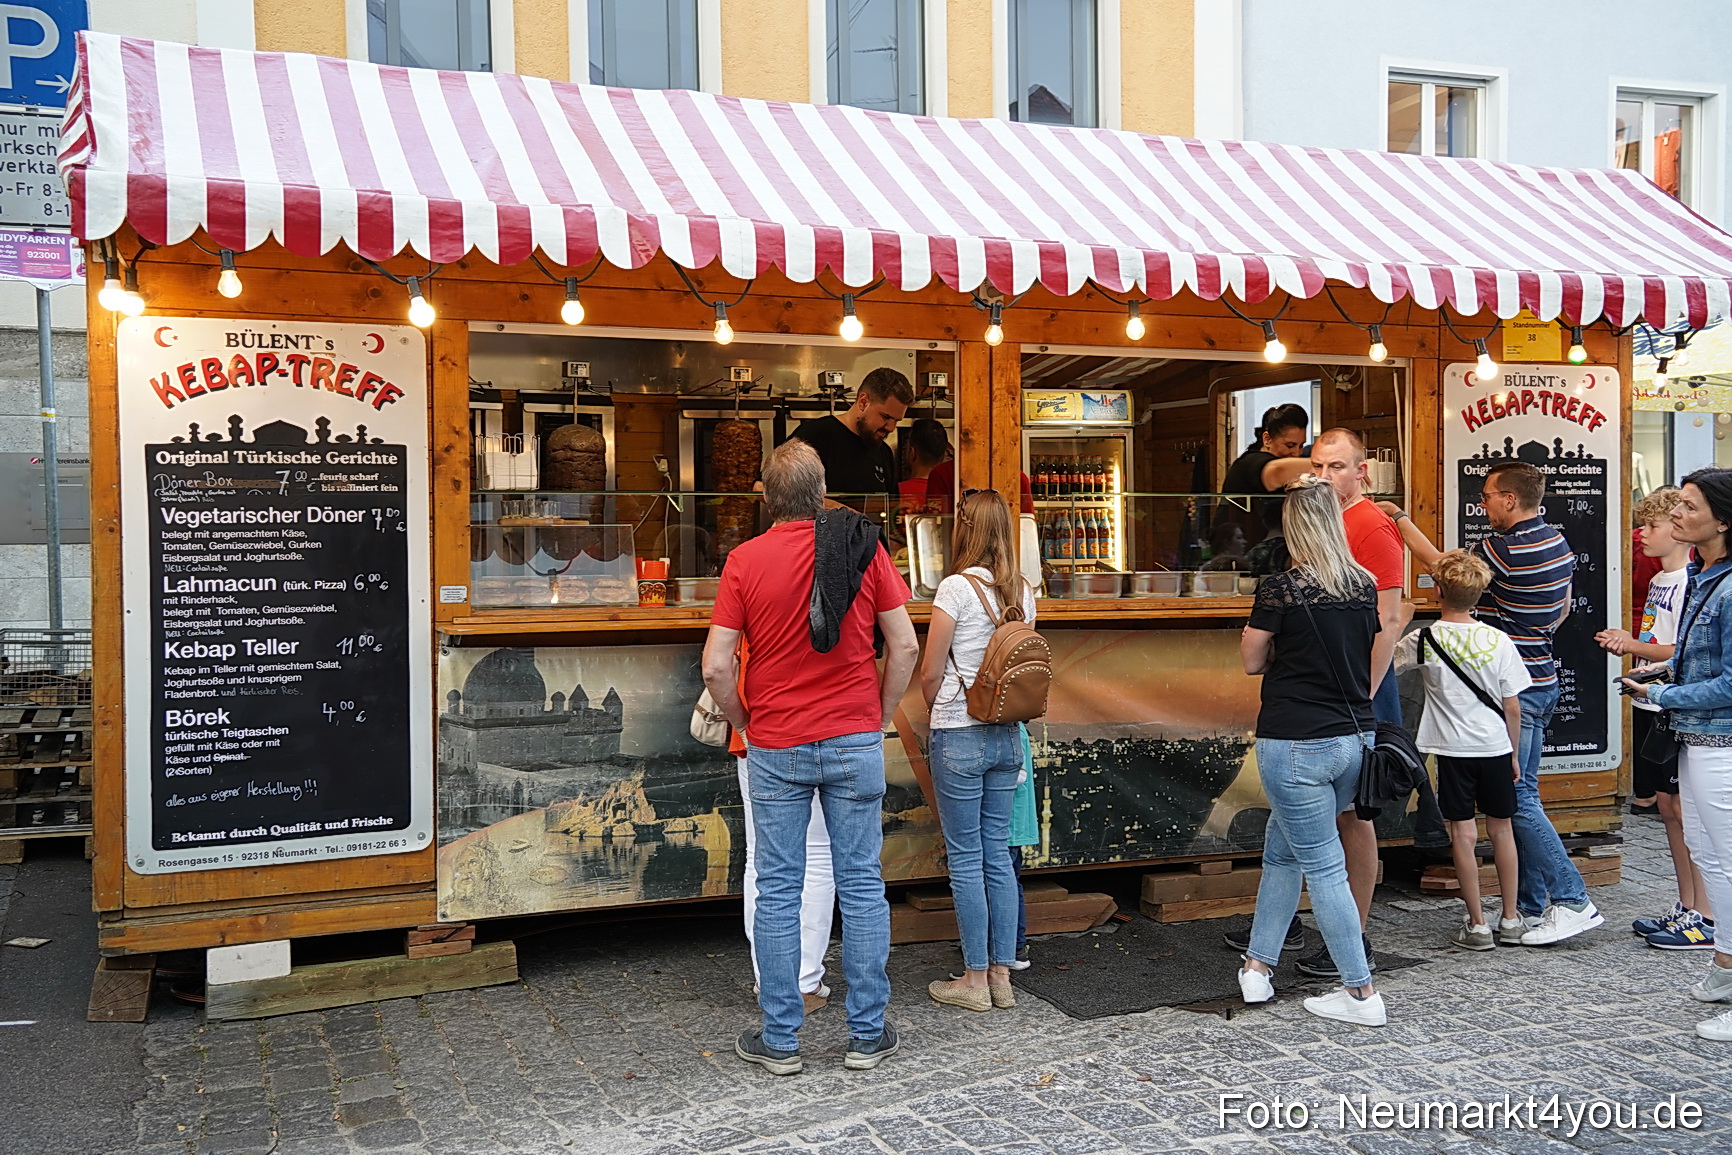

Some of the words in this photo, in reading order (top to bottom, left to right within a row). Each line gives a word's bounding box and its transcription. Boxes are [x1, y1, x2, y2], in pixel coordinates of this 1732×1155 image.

[0, 3, 60, 90] P
[38, 123, 60, 138] mi
[0, 139, 57, 156] rksch
[0, 158, 56, 175] erkta
[43, 202, 70, 217] 8-1
[27, 250, 61, 260] 923001
[1512, 321, 1551, 329] Standnummer
[1527, 333, 1537, 342] 38
[149, 352, 406, 411] KEBAP-TREFF
[1460, 389, 1608, 433] KEBAP-TREFF
[155, 450, 230, 467] Original
[233, 450, 322, 464] Türkische
[325, 450, 398, 465] Gerichte
[349, 472, 380, 481] scharf
[1558, 464, 1603, 475] Gerichte
[153, 473, 201, 491] Döner
[203, 471, 233, 487] Box
[321, 484, 335, 492] bis
[380, 483, 399, 492] fein
[160, 506, 302, 528] Vegetarischer
[306, 506, 367, 523] Döner
[161, 530, 192, 540] belegt
[194, 530, 210, 538] mit
[212, 529, 279, 540] angemachtem
[281, 529, 308, 538] Käse,
[1464, 532, 1482, 541] belegt
[161, 541, 206, 551] Tomaten,
[208, 541, 286, 550] Gemüsezwiebel,
[288, 540, 322, 549] Gurken
[162, 552, 221, 563] Eisbergsalat
[223, 553, 242, 561] und
[243, 552, 305, 563] Joghurtsoße.
[163, 575, 277, 593] Lahmacun
[283, 580, 312, 593] (türk.
[314, 579, 347, 591] Pizza)
[162, 596, 179, 605] mit
[180, 595, 238, 604] Rinderhack,
[163, 608, 193, 618] belegt
[195, 607, 211, 615] mit
[216, 606, 260, 615] Tomaten,
[262, 604, 338, 614] Gemüsezwiebel,
[163, 619, 222, 629] Eisbergsalat
[224, 618, 242, 627] und
[244, 616, 306, 627] Joghurtsoße.
[164, 640, 236, 661] Kebap
[241, 638, 300, 656] Teller
[164, 666, 196, 676] Kebap
[198, 666, 210, 674] im
[212, 665, 238, 673] Teller
[240, 664, 255, 672] mit
[257, 662, 314, 673] gemischtem
[316, 660, 342, 670] Salat,
[164, 677, 224, 688] Joghurtsoße
[226, 676, 245, 684] und
[247, 674, 302, 684] knusprigem
[164, 689, 219, 699] Fladenbrot.
[221, 687, 236, 697] und
[165, 707, 231, 728] Börek
[165, 729, 219, 741] türkische
[221, 726, 289, 739] Teigtaschen
[165, 743, 195, 754] gefüllt
[197, 742, 213, 751] mit
[215, 741, 239, 750] Käse
[241, 740, 263, 749] oder
[265, 738, 281, 747] mit
[1556, 743, 1572, 752] und
[1572, 742, 1598, 752] Frische
[165, 755, 190, 765] Käse
[192, 754, 211, 763] und
[1570, 761, 1594, 769] 09181-22
[165, 794, 186, 807] alles
[188, 793, 207, 804] aus
[210, 786, 242, 801] eigener
[247, 780, 303, 801] Herstellung
[171, 830, 226, 843] Bekannt
[229, 826, 268, 840] durch
[270, 821, 322, 836] Qualität
[325, 819, 349, 830] und
[351, 816, 394, 828] Frische
[158, 856, 219, 868] Rosengasse
[222, 854, 234, 863] 15
[241, 851, 270, 861] 92318
[272, 847, 318, 858] Neumarkt
[325, 846, 344, 854] Tel.:
[346, 841, 386, 852] 09181-22
[388, 839, 399, 848] 66
[401, 838, 407, 847] 3
[1682, 926, 1707, 944] N
